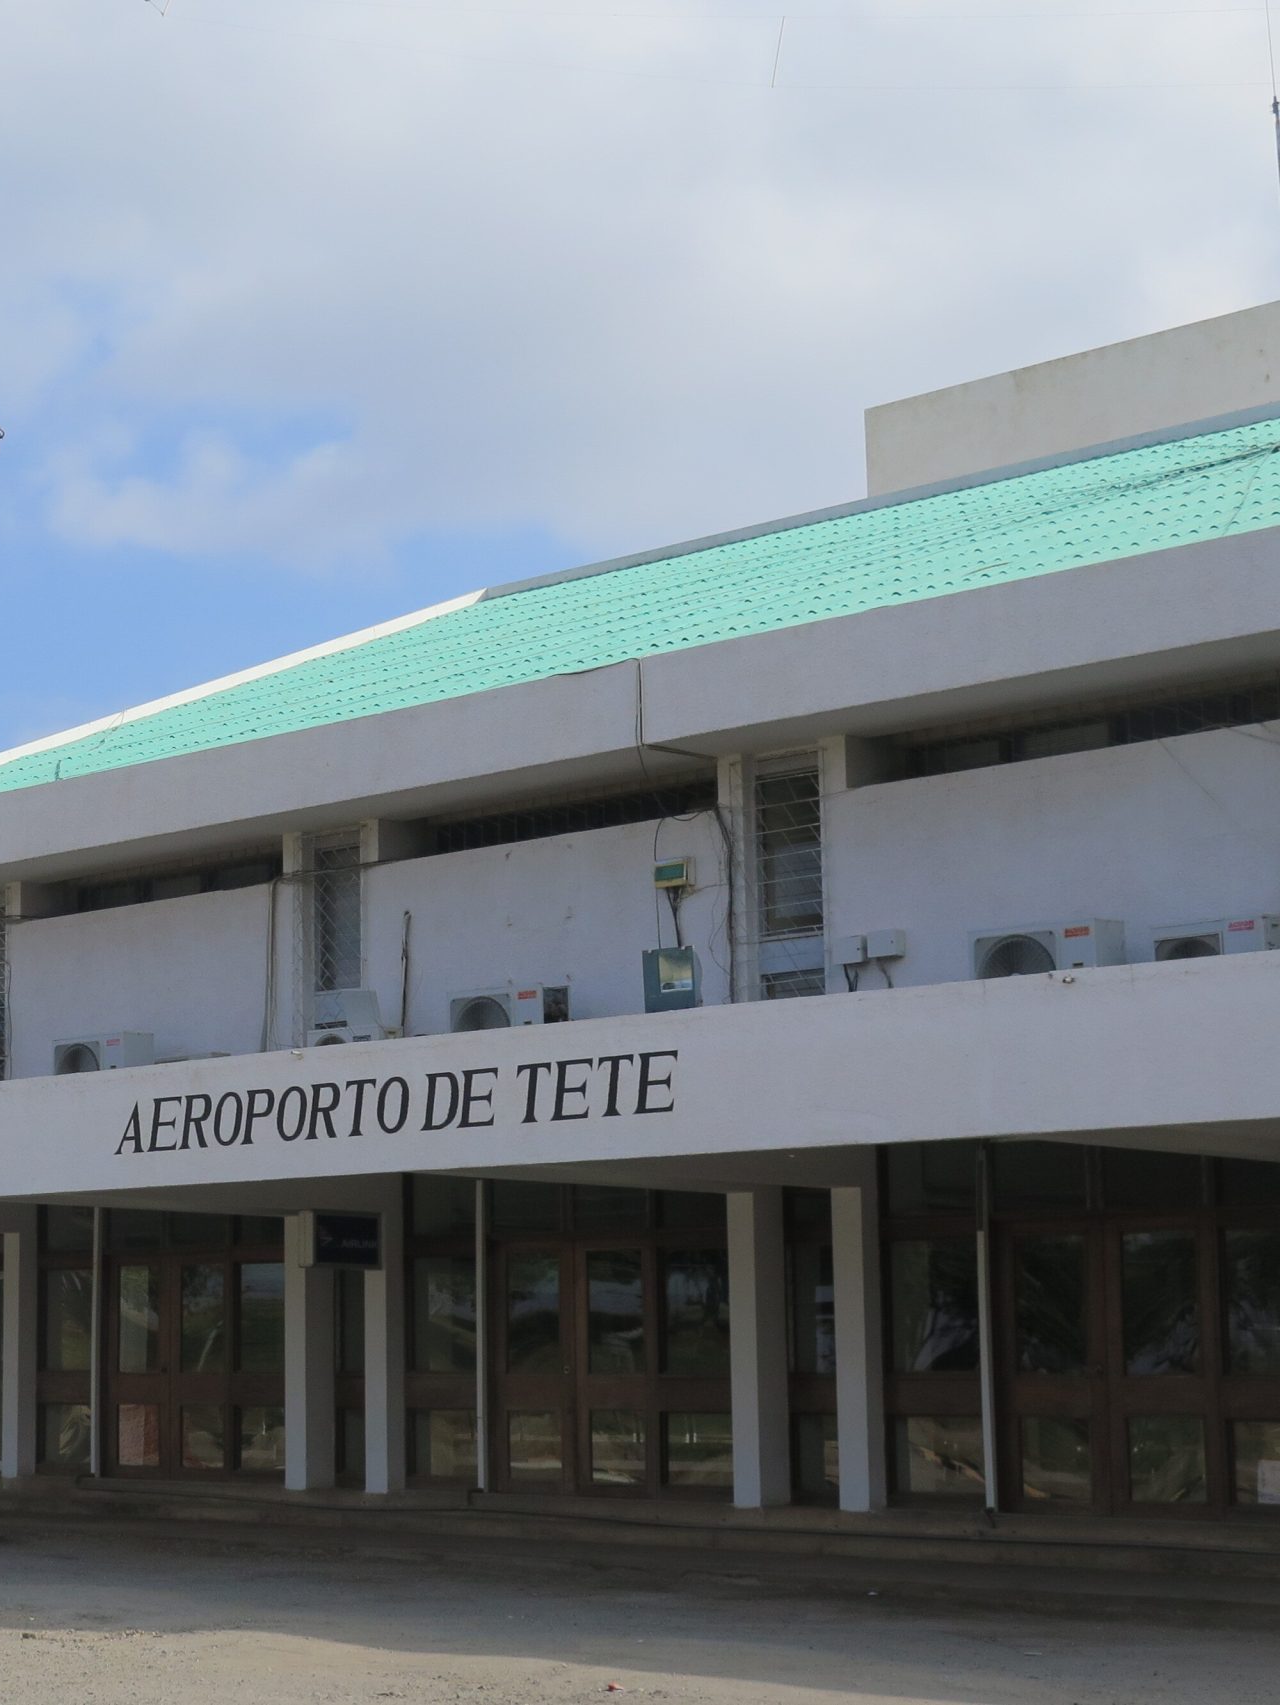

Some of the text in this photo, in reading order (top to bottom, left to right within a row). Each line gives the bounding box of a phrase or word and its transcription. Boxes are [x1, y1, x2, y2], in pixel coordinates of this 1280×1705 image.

[114, 1049, 679, 1155] AEROPORTO DE TETE
